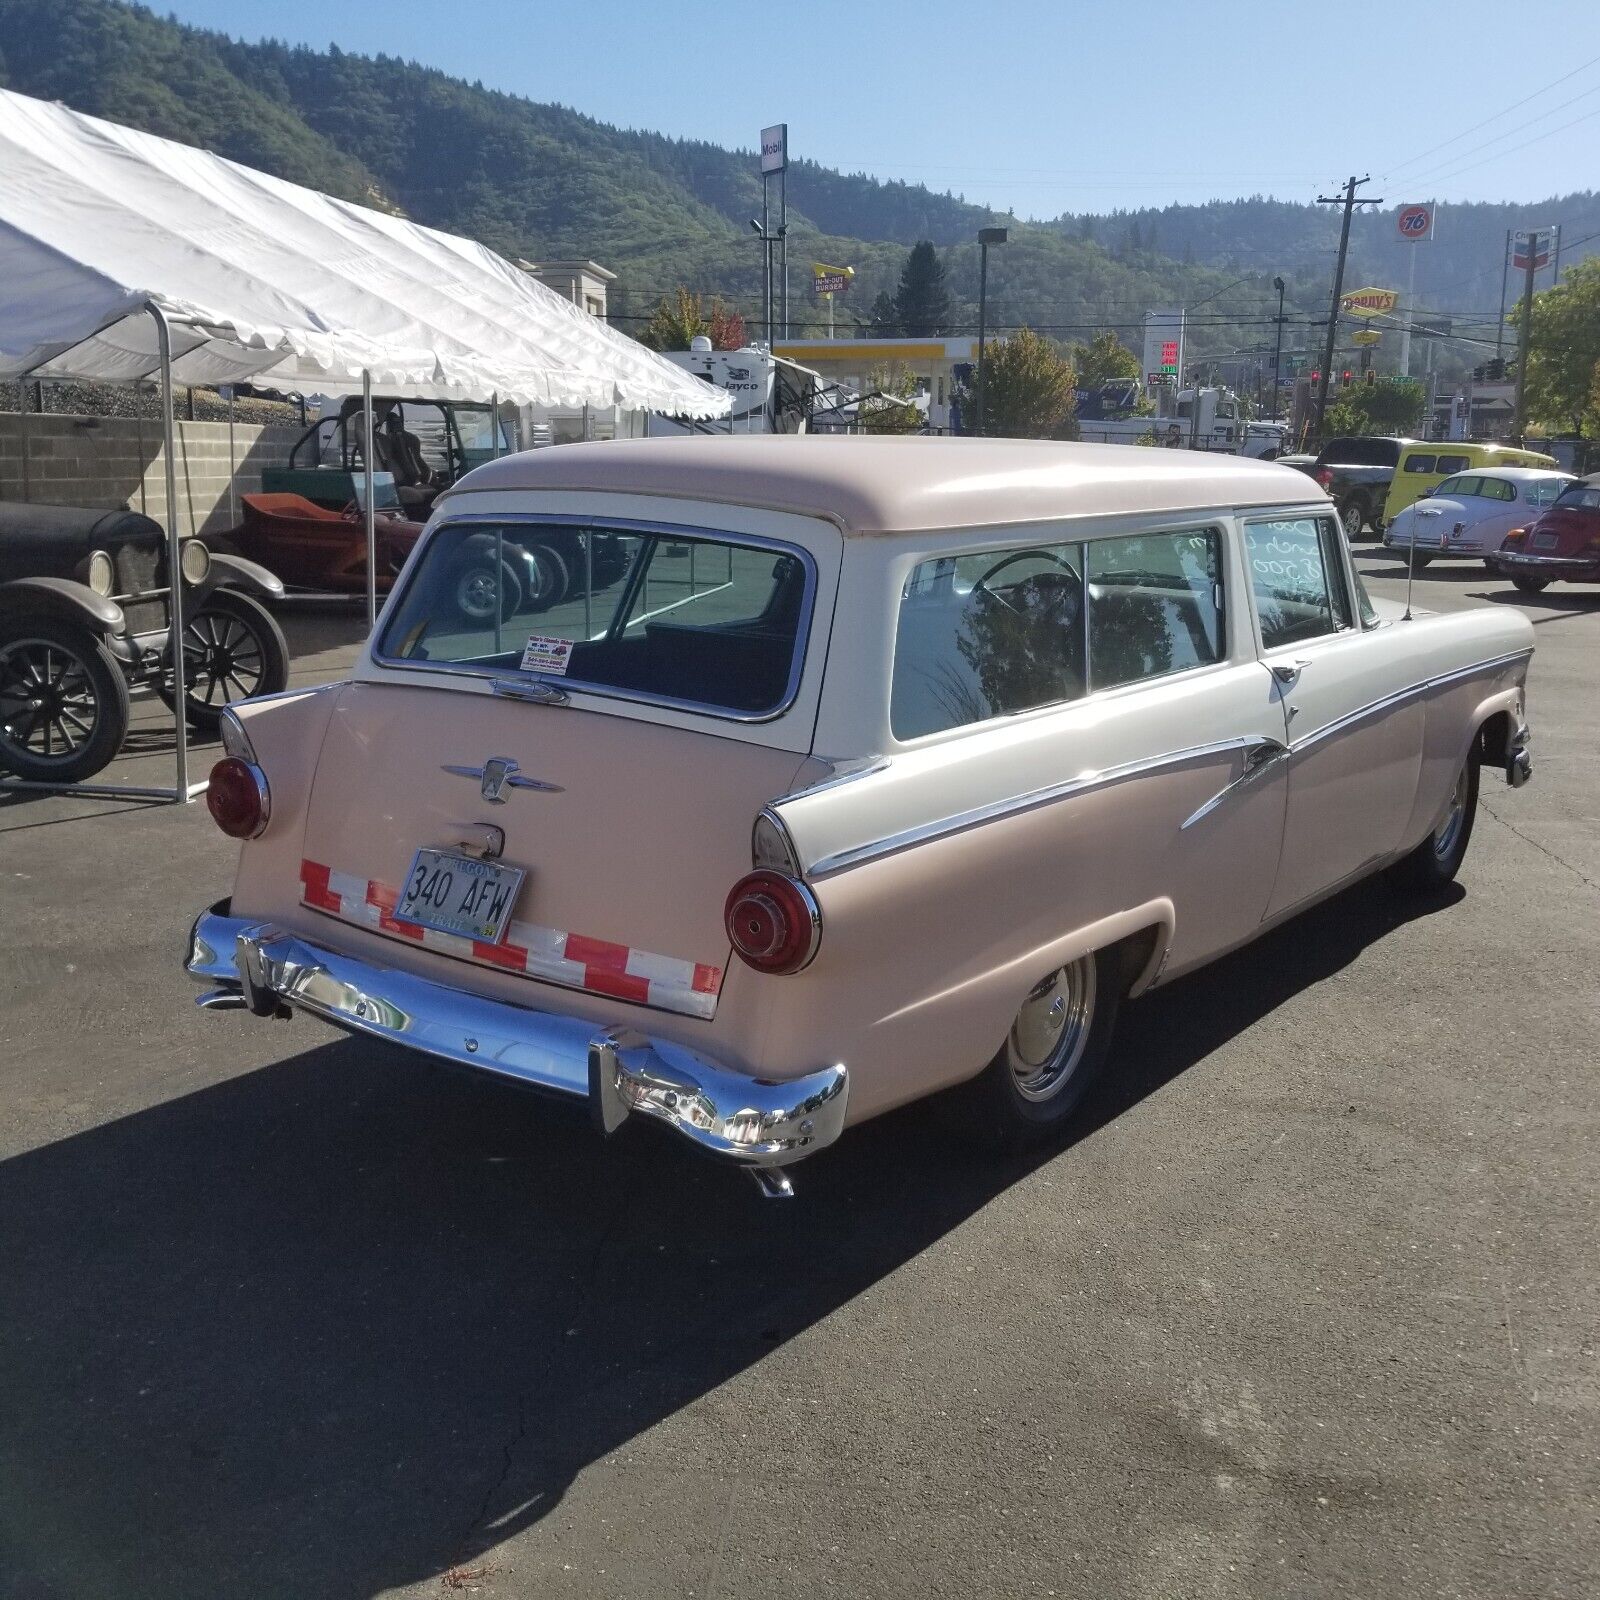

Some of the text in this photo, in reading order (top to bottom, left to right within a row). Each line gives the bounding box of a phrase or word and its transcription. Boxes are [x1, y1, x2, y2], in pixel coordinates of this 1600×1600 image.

[762, 140, 782, 156] Mobil
[1402, 212, 1425, 231] 76
[815, 276, 843, 285] IN-N-OUT
[815, 284, 843, 292] BURGER
[721, 381, 758, 391] Jayco
[407, 865, 512, 923] 340 AFW
